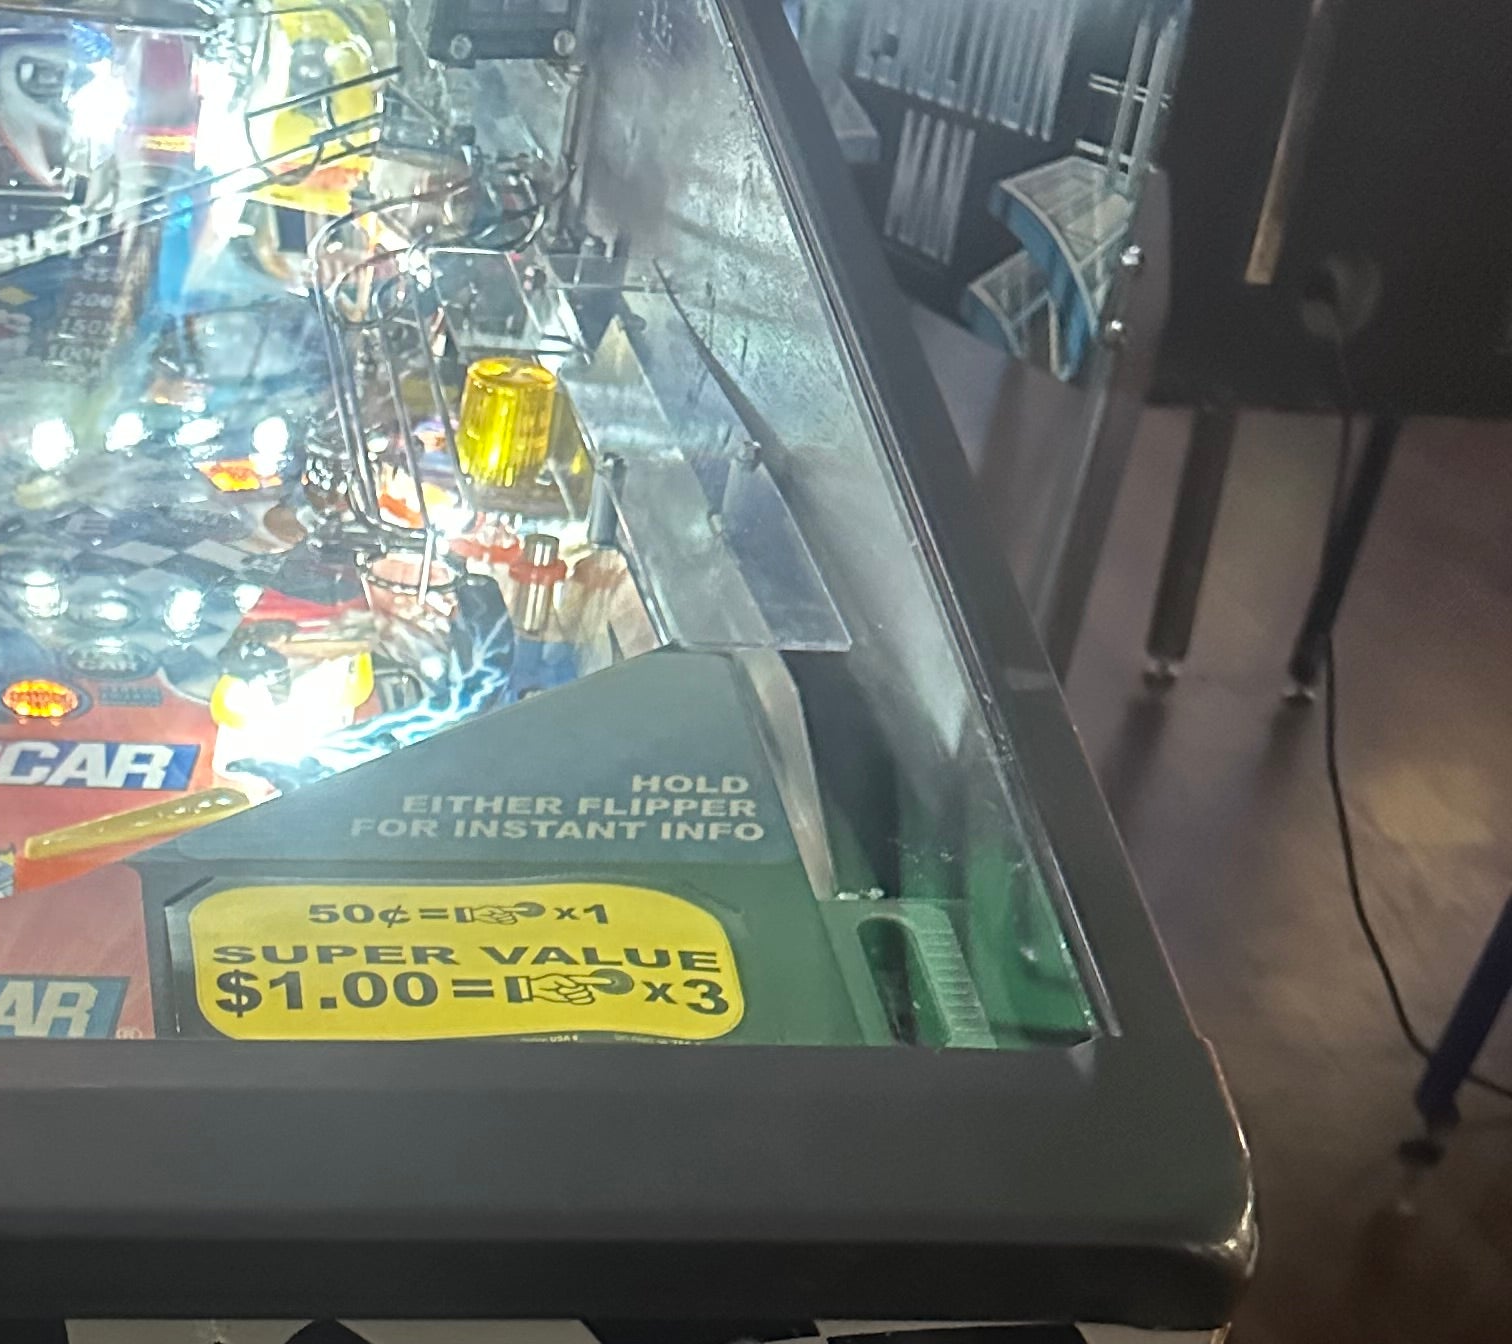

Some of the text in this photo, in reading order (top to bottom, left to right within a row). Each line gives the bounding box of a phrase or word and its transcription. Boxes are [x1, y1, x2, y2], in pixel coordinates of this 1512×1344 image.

[631, 774, 750, 794] HOLD
[402, 794, 757, 818] EITHER FLIPPER
[350, 818, 766, 842] FOR INSTANT INFO
[554, 903, 609, 925] x1
[212, 945, 723, 973] SUPER VALUE
[642, 978, 730, 1016] x3
